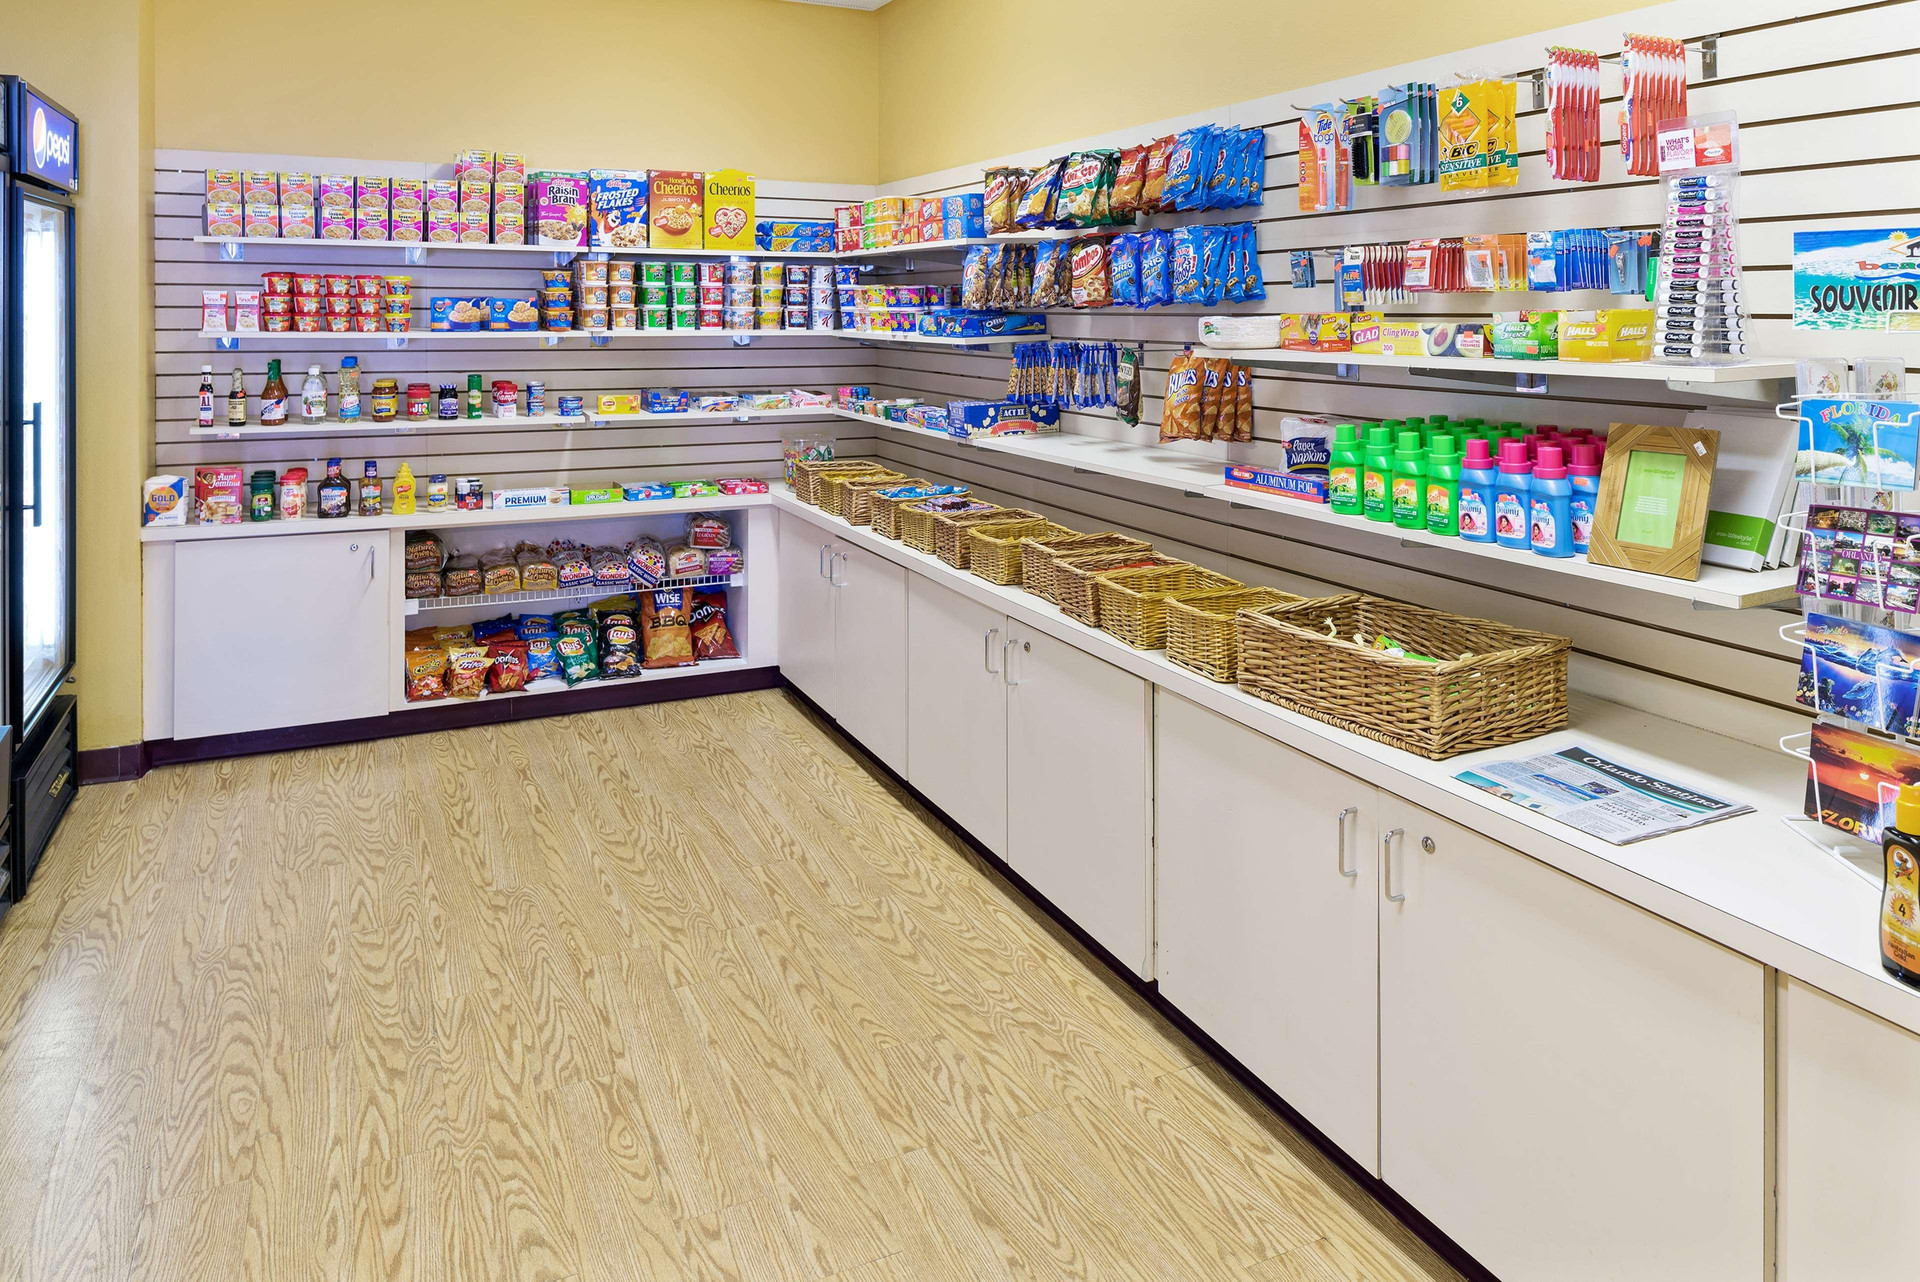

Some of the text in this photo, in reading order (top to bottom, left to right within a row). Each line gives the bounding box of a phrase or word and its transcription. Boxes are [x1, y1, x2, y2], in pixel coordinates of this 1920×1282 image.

[1457, 97, 1463, 108] 6
[1317, 118, 1332, 131] Tide
[1666, 136, 1690, 145] WHAT'S
[46, 130, 70, 167] pepsi
[1450, 144, 1477, 159] BIC
[1666, 144, 1684, 152] YOUR
[1667, 149, 1694, 158] FLAVOR?
[1440, 158, 1482, 173] SENSITIVE
[548, 186, 579, 198] Raisin
[653, 180, 698, 196] Cheerios
[709, 182, 751, 196] Cheerios
[552, 195, 576, 207] Bran
[597, 188, 639, 202] FROSTED
[597, 197, 634, 210] FLAKES
[1810, 284, 1918, 313] SOUVENIR
[1382, 327, 1419, 338] Cling Wrap
[1505, 324, 1525, 333] HALLS
[1567, 326, 1597, 336] HALLS
[1620, 326, 1647, 336] HALLS
[1353, 328, 1379, 343] GLAD
[1003, 408, 1016, 417] ACT
[1820, 402, 1901, 428] FLORIDA
[1292, 440, 1315, 452] Paper
[1290, 451, 1327, 464] Napkins
[217, 473, 237, 482] Aunt
[1255, 474, 1297, 492] ALUMINUM
[1334, 476, 1349, 485] Gain
[208, 479, 242, 489] Jemima
[1395, 487, 1410, 496] Gain
[151, 494, 175, 502] GOLD
[505, 495, 547, 506] PREMIUM
[1460, 503, 1482, 516] Downy
[1496, 504, 1520, 517] Downy
[634, 557, 661, 577] WONDER
[562, 572, 592, 581] WONDER
[600, 571, 628, 580] WONDER
[654, 592, 682, 604] WISE
[649, 614, 688, 630] BBQ
[1583, 756, 1726, 810] Orlando Sentinel
[1898, 903, 1907, 917] 4
[1887, 940, 1916, 961] Australian
